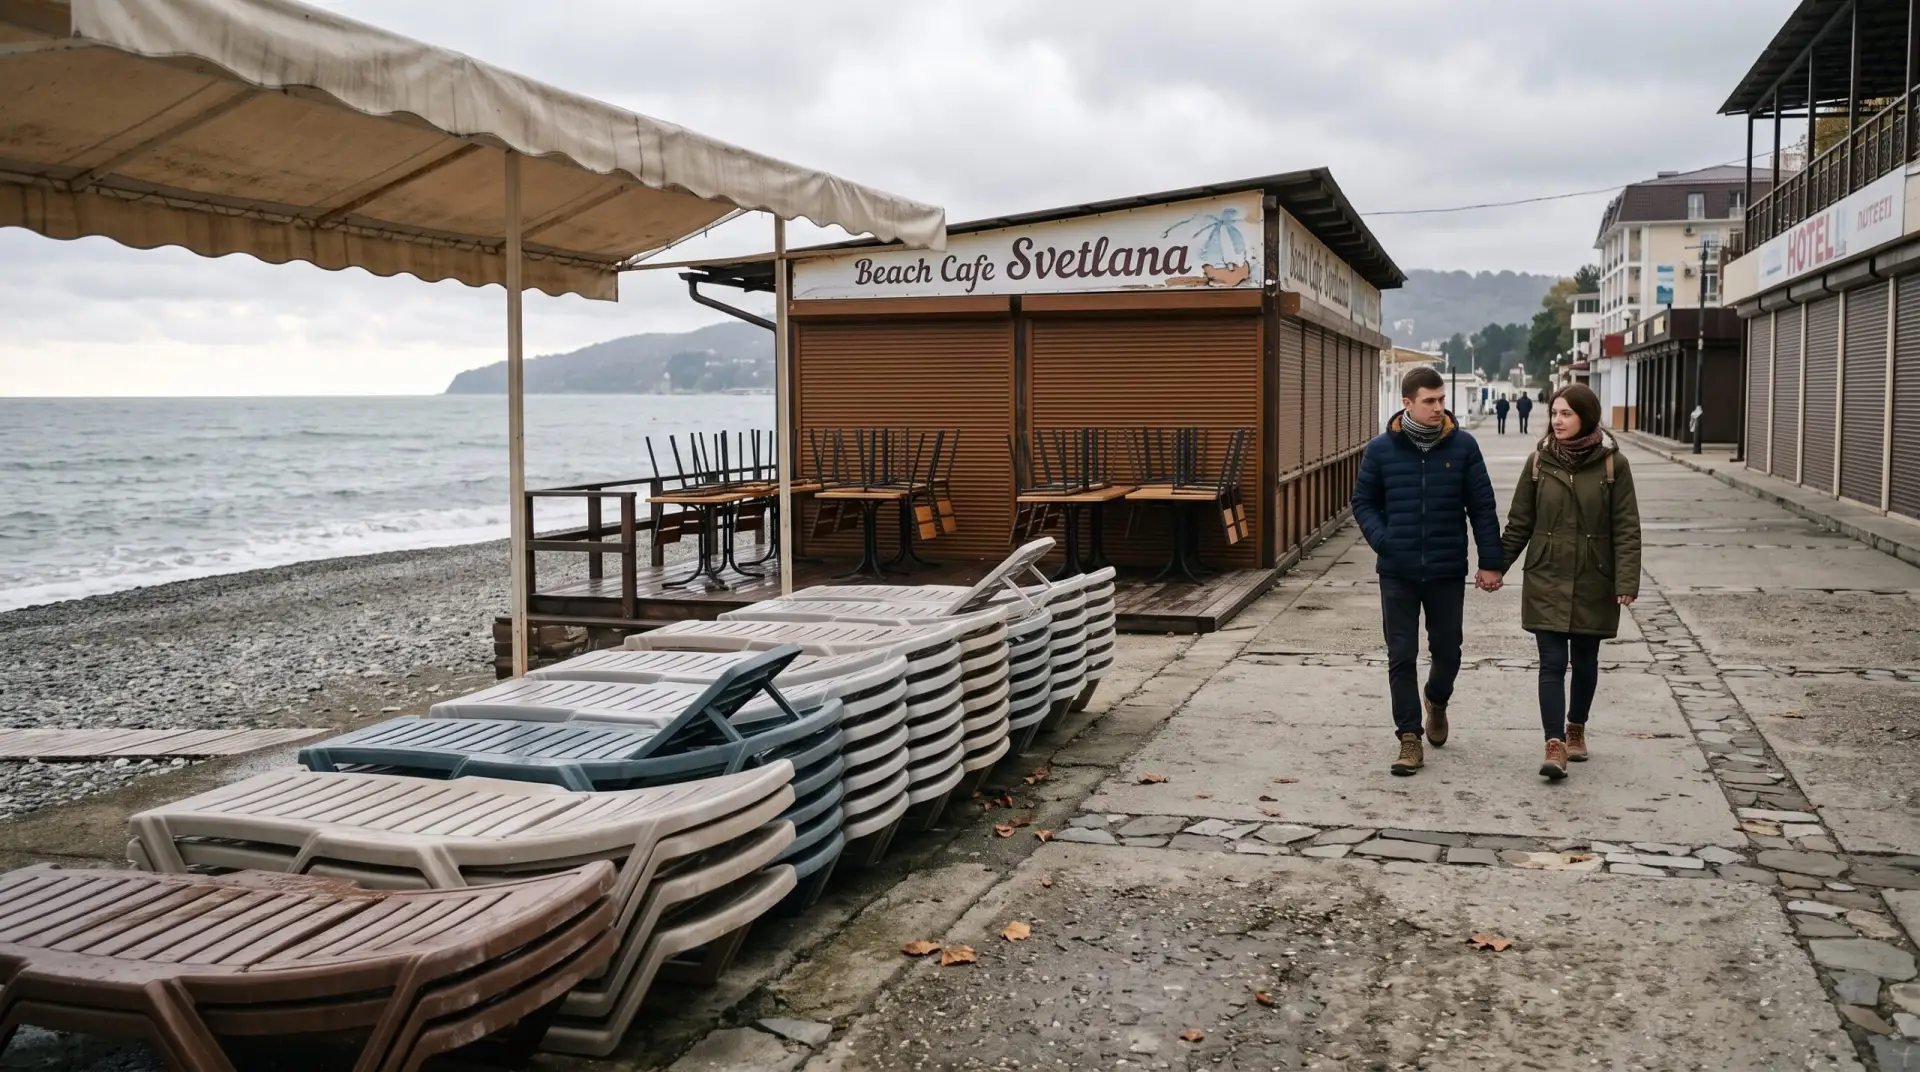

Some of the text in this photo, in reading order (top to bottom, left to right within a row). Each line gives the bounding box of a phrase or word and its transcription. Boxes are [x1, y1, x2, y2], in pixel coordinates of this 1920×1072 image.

[854, 236, 1192, 293] Beach Cafe Svetlana
[1787, 212, 1833, 276] HOTEL
